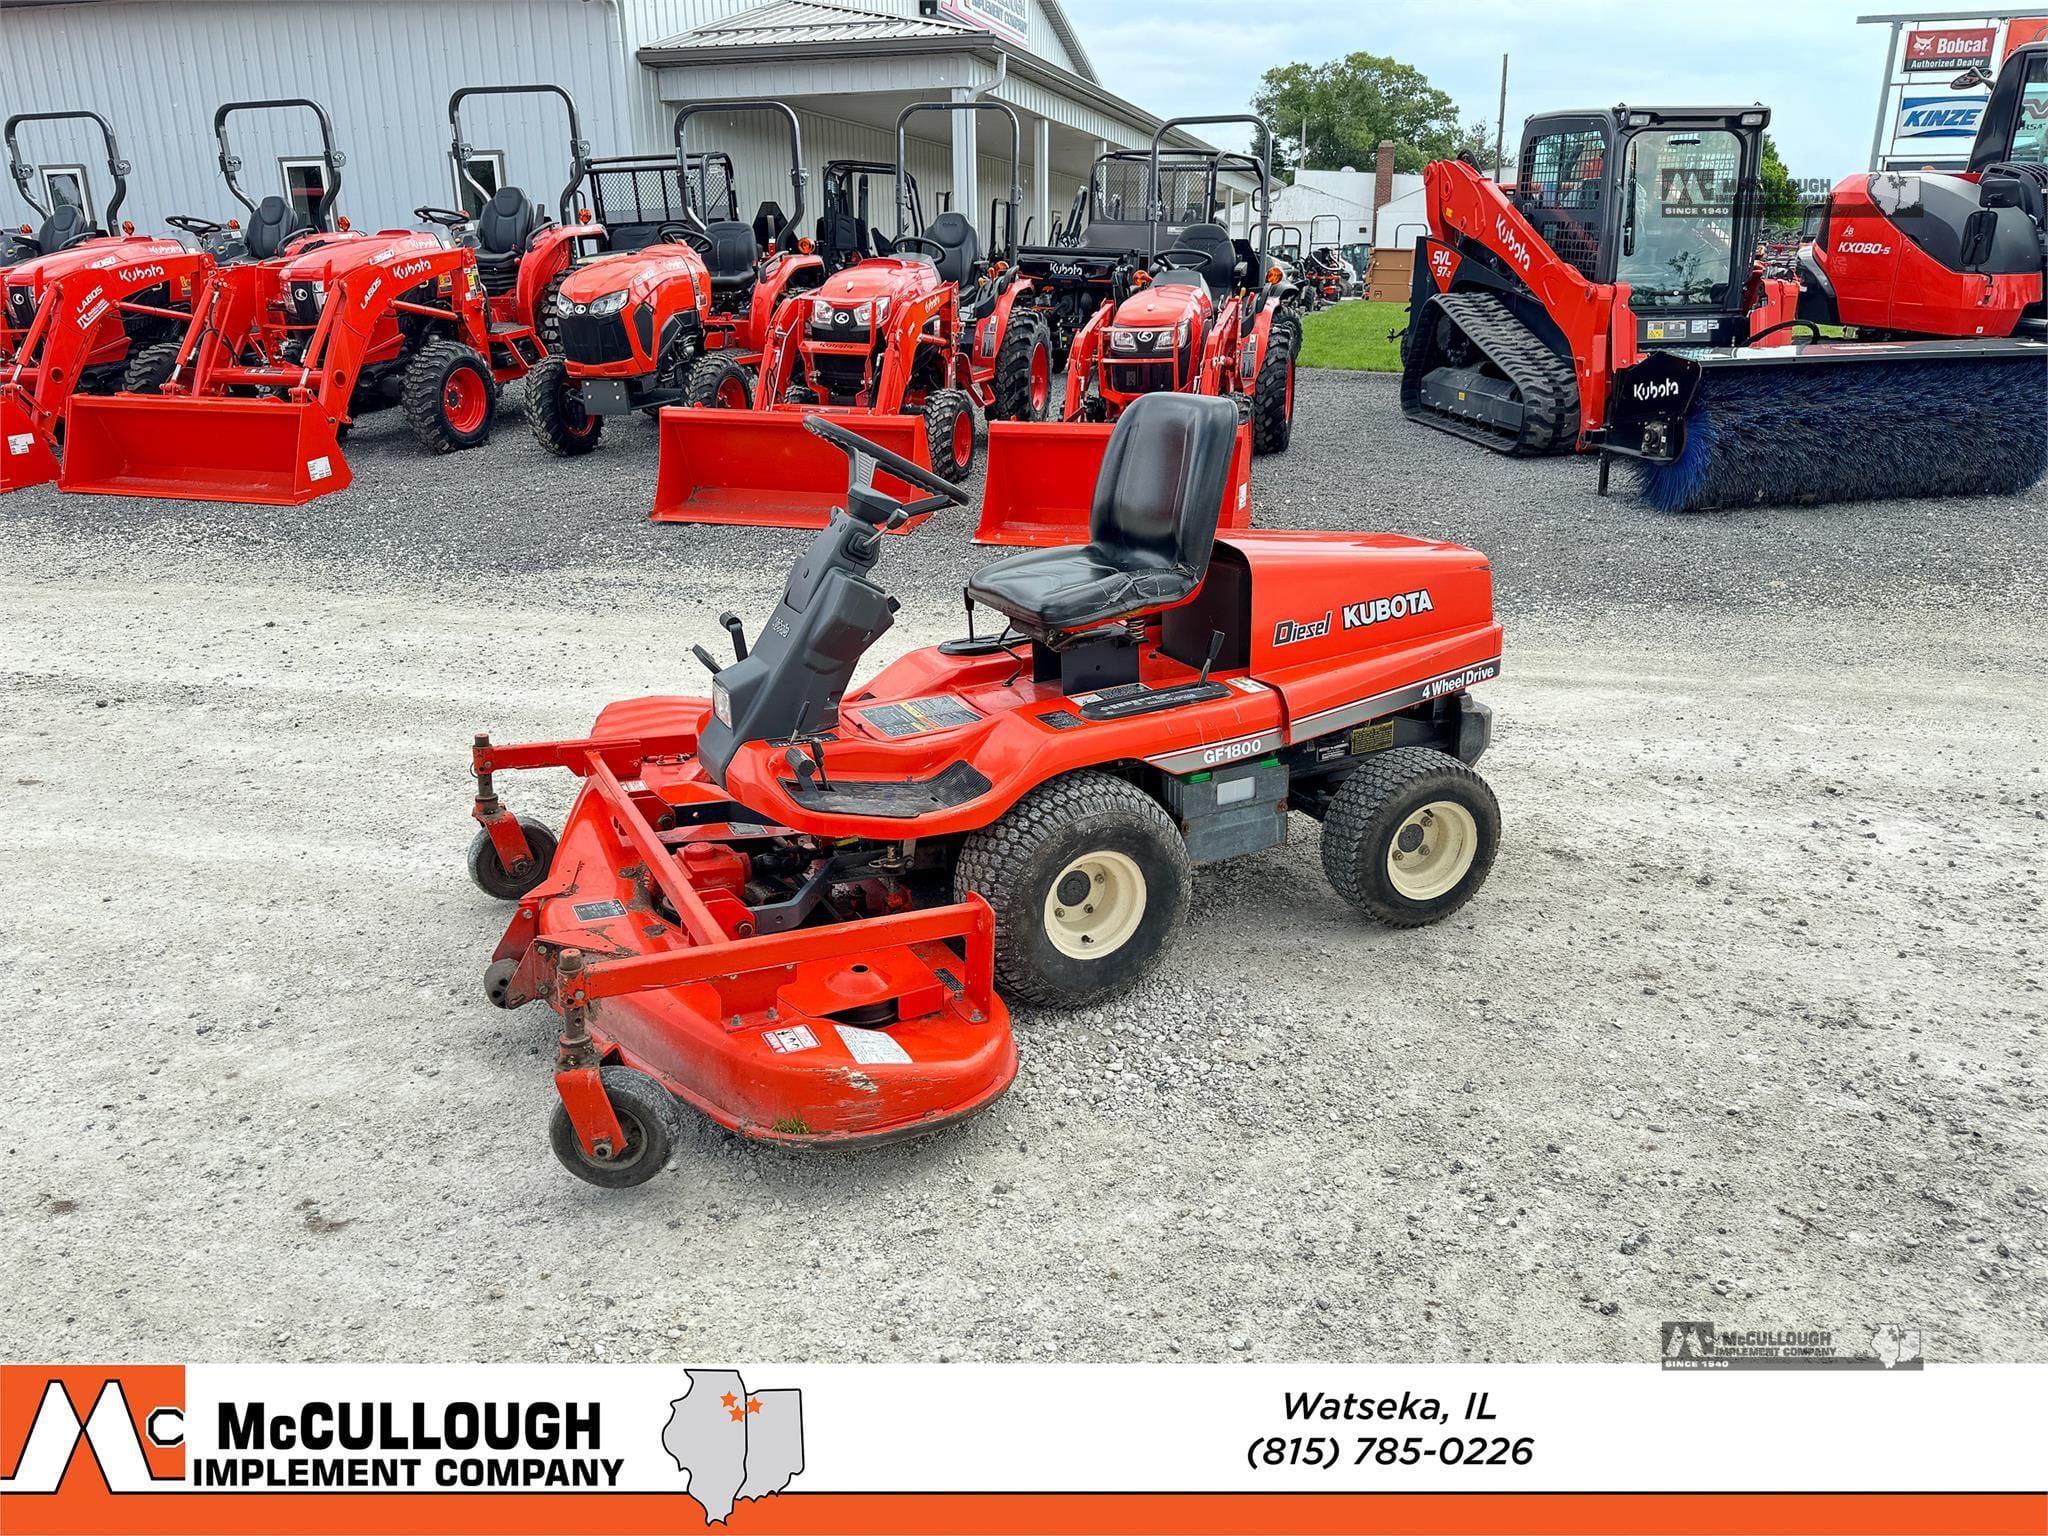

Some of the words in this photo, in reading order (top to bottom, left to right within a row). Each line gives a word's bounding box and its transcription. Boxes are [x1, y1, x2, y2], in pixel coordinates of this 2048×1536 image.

[1936, 36, 1988, 54] Bobcat
[1911, 57, 1955, 69] Authorized
[1956, 57, 1984, 67] Dealer
[1903, 108, 1983, 128] KINZE
[1495, 213, 1531, 272] Kubota
[1432, 250, 1452, 265] SVL
[119, 264, 165, 282] Kubota
[392, 258, 432, 279] Kubota
[1050, 262, 1084, 276] Kubota
[1633, 377, 1679, 401] Kubota
[1272, 610, 1333, 648] Diesel
[1341, 588, 1434, 630] KUBOTA
[1422, 684, 1431, 699] 4
[1431, 673, 1466, 697] Wheel
[1466, 665, 1494, 687] Drive
[1203, 739, 1262, 764] GF1800
